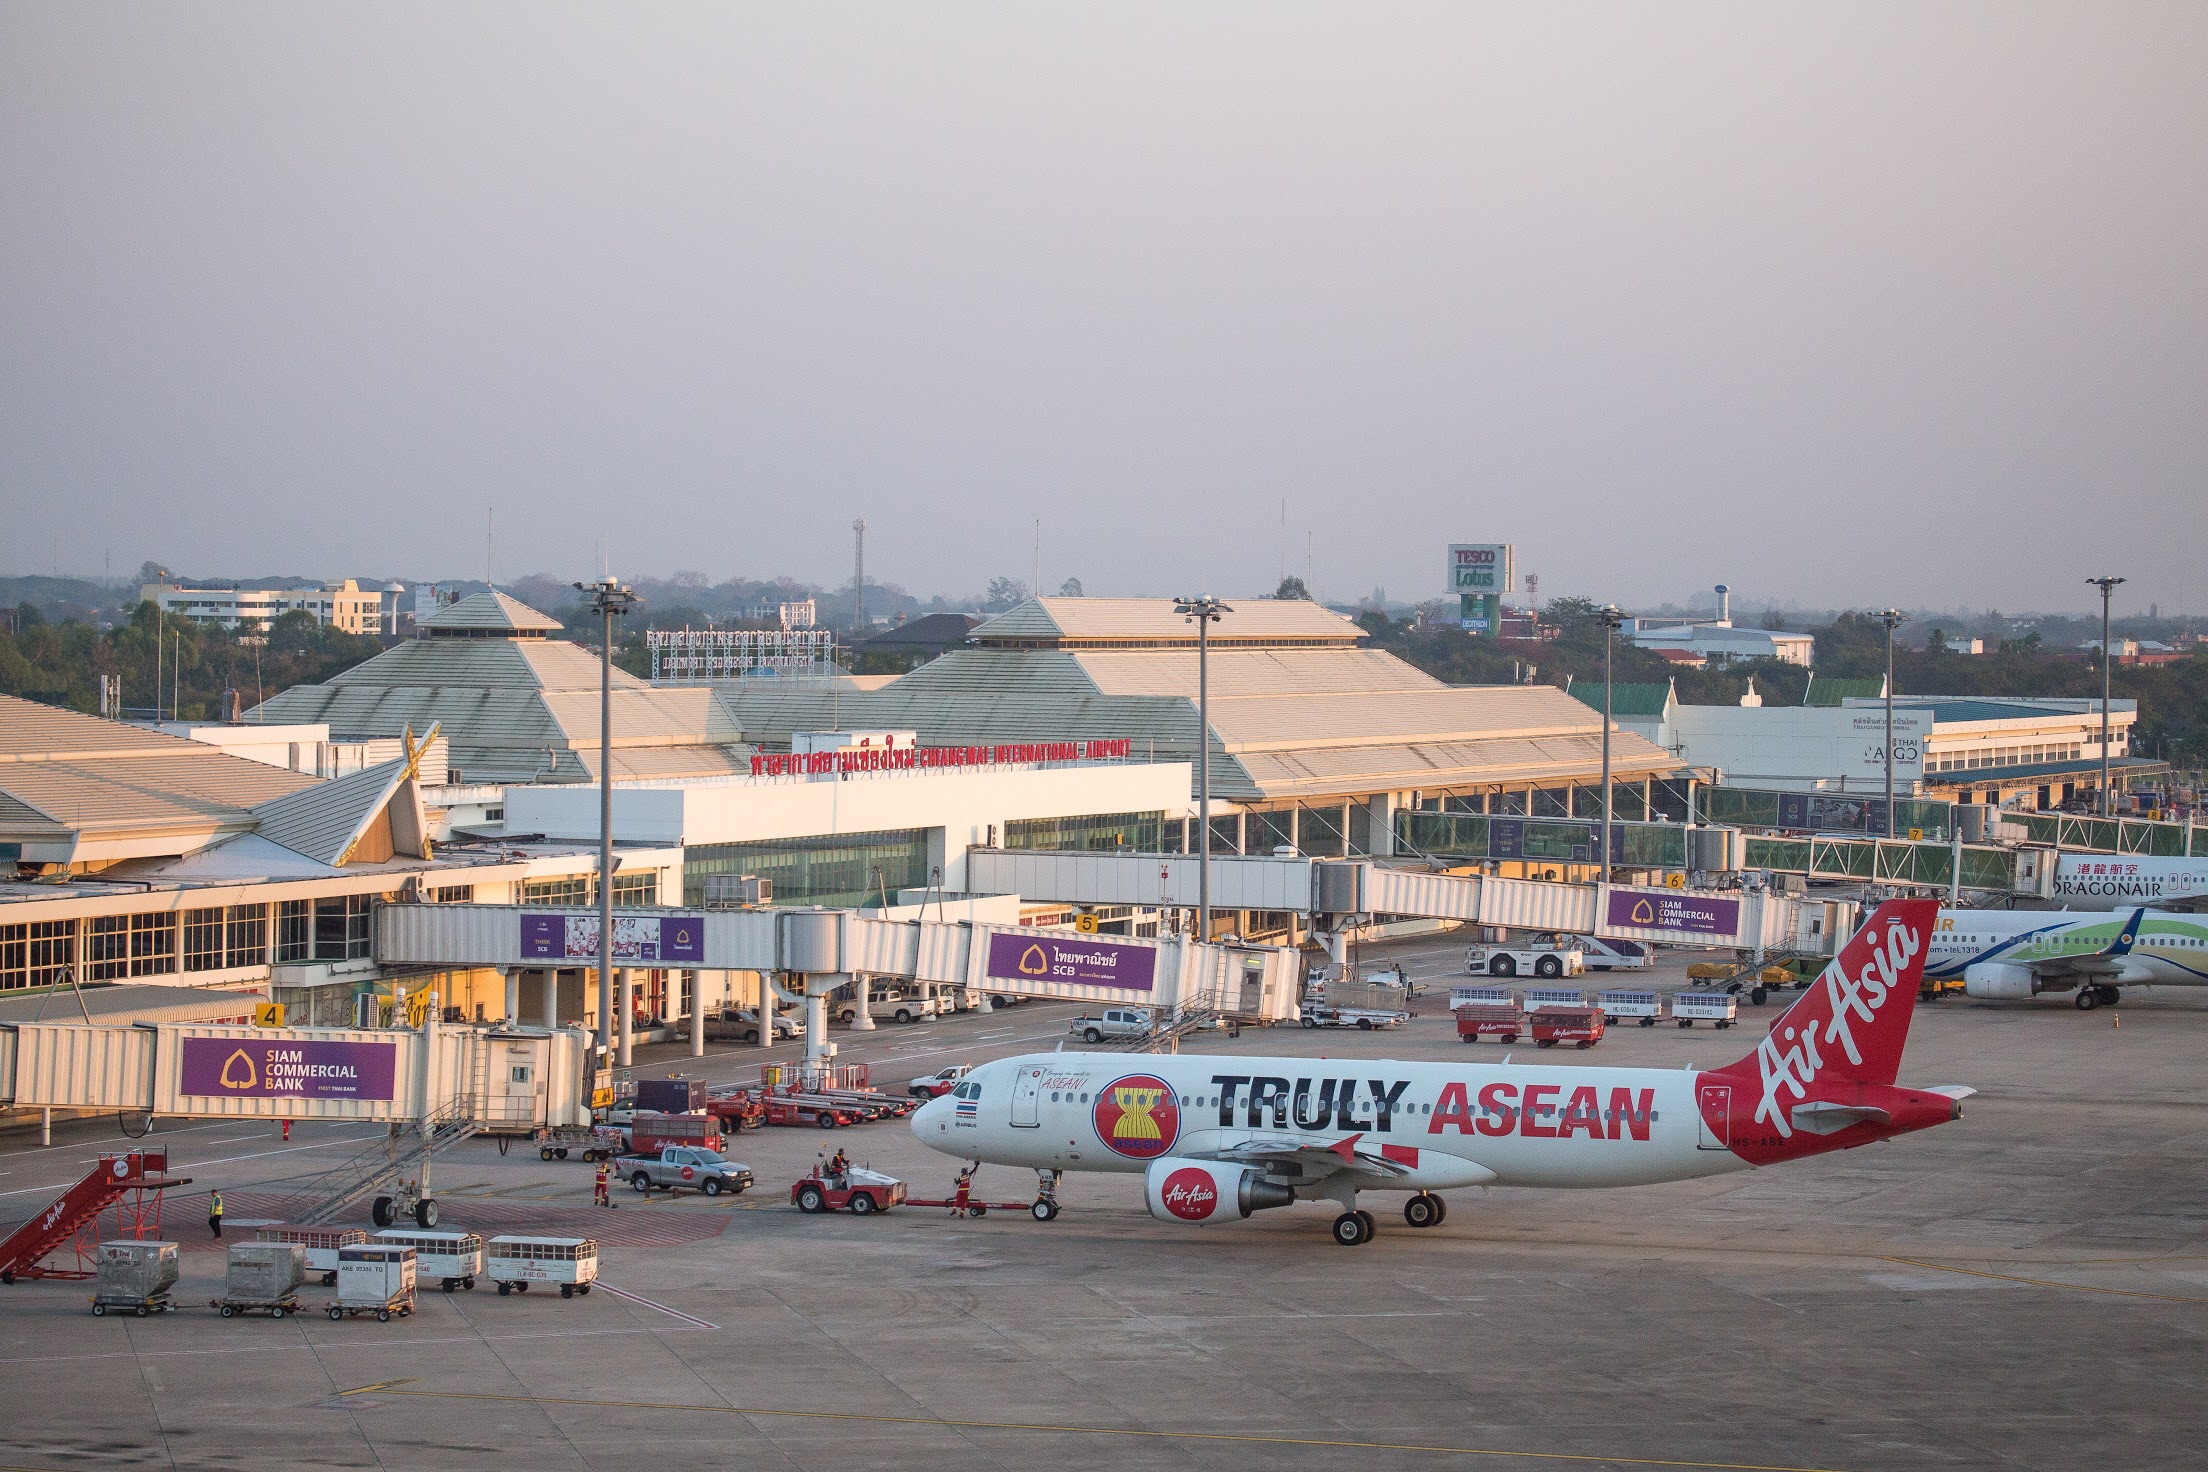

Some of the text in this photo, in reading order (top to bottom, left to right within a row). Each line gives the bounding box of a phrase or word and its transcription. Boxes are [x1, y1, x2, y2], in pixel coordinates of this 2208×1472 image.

[1455, 550, 1495, 563] TESCO
[1456, 570, 1494, 586] Lotus
[1462, 620, 1488, 628] DECATHLON
[751, 735, 915, 775] ท่าอากาศยานเชียงใหม่
[994, 742, 1080, 764] INTERNATIONAL
[1085, 738, 1131, 759] AIRPORT
[2152, 811, 2157, 820] 8
[1912, 829, 1920, 840] 7
[2077, 863, 2138, 875] 港龍航空
[1671, 875, 1679, 887] 6
[1659, 900, 1682, 909] SIAM
[1659, 908, 1715, 921] COMMERCIAL
[1082, 916, 1092, 930] 5
[1658, 917, 1682, 927] BANK
[1053, 946, 1119, 968] ไทยพาณิชย์
[1053, 965, 1075, 976] SCB
[264, 1006, 276, 1025] 4
[266, 1050, 303, 1063] SIAM
[265, 1063, 358, 1078] COMMERCIAL
[265, 1077, 304, 1091] BANK
[1041, 1077, 1088, 1090] ASEAN!
[1211, 1075, 1656, 1141] TRULY ASEAN
[1113, 1138, 1164, 1150] asean
[1732, 1137, 1786, 1147] HS-ABE
